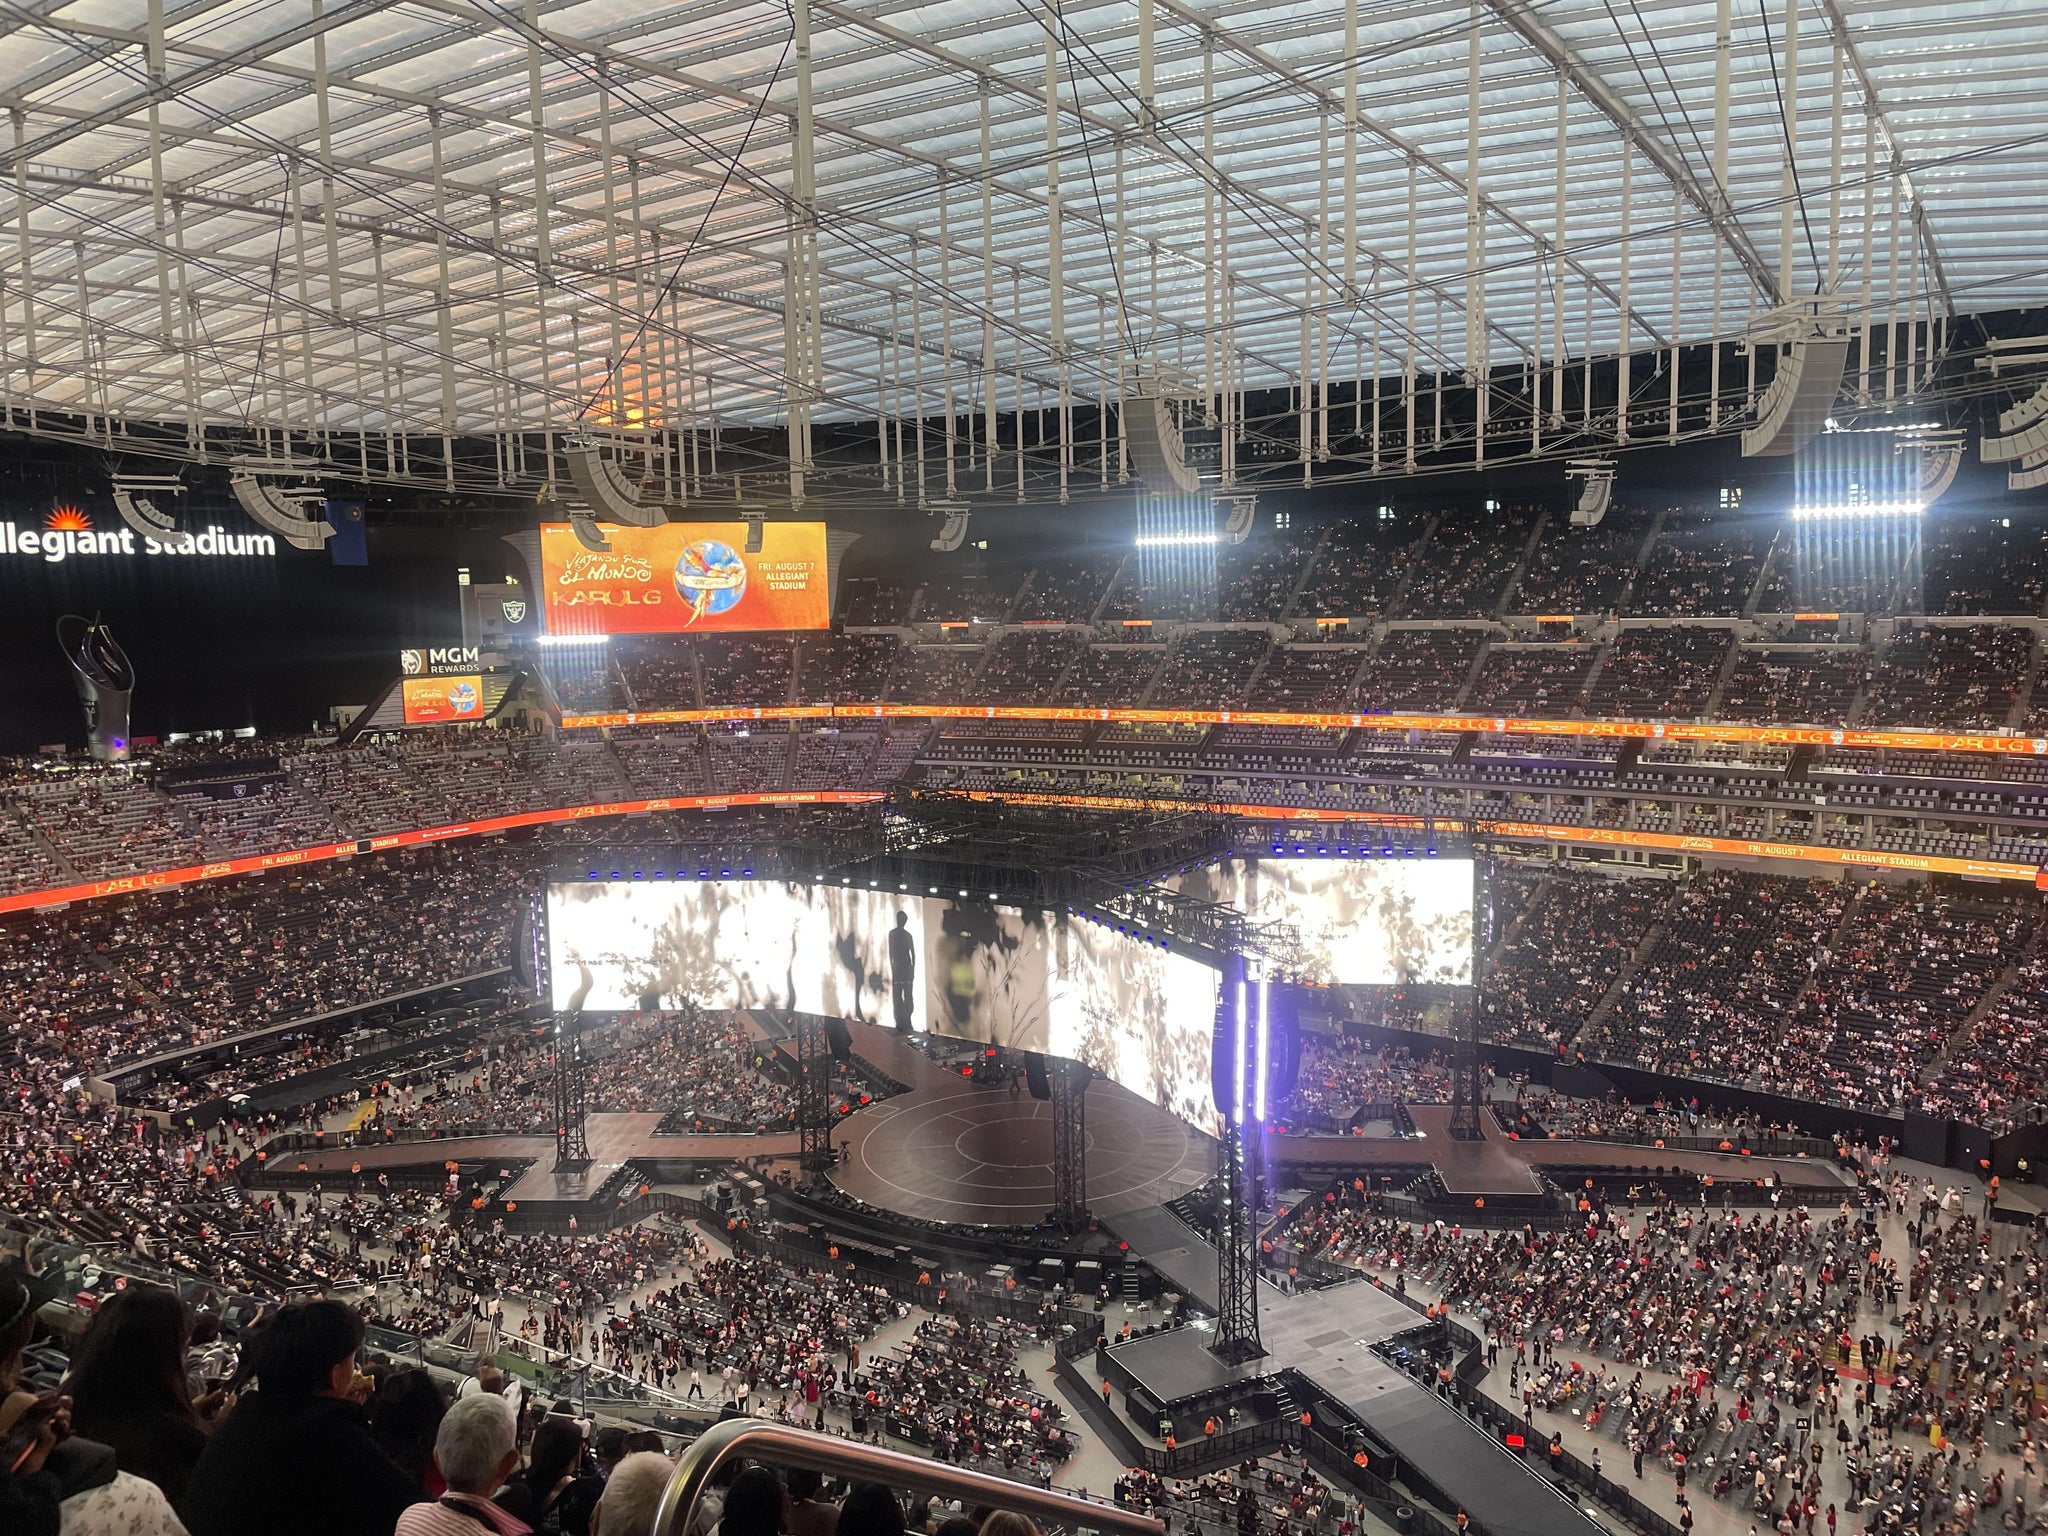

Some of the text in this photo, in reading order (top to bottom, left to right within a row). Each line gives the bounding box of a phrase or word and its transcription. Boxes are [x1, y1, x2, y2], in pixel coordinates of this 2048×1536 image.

[623, 554, 653, 569] POR
[775, 562, 807, 571] AUGUST
[810, 562, 815, 571] 7
[559, 563, 652, 585] EL MUNDO
[765, 572, 809, 580] ALLEGIANT
[769, 581, 806, 590] STADIUM
[642, 588, 662, 605] G
[430, 647, 479, 664] MGM
[430, 664, 480, 674] REWARDS
[335, 838, 399, 855] ALLEGI STADIUM
[1765, 846, 1797, 856] AUGUST
[276, 853, 302, 864] AUGUST
[1841, 853, 1929, 867] ALLEGIANT STADIUM
[125, 1079, 141, 1089] CLUB
[900, 1427, 911, 1437] B2
